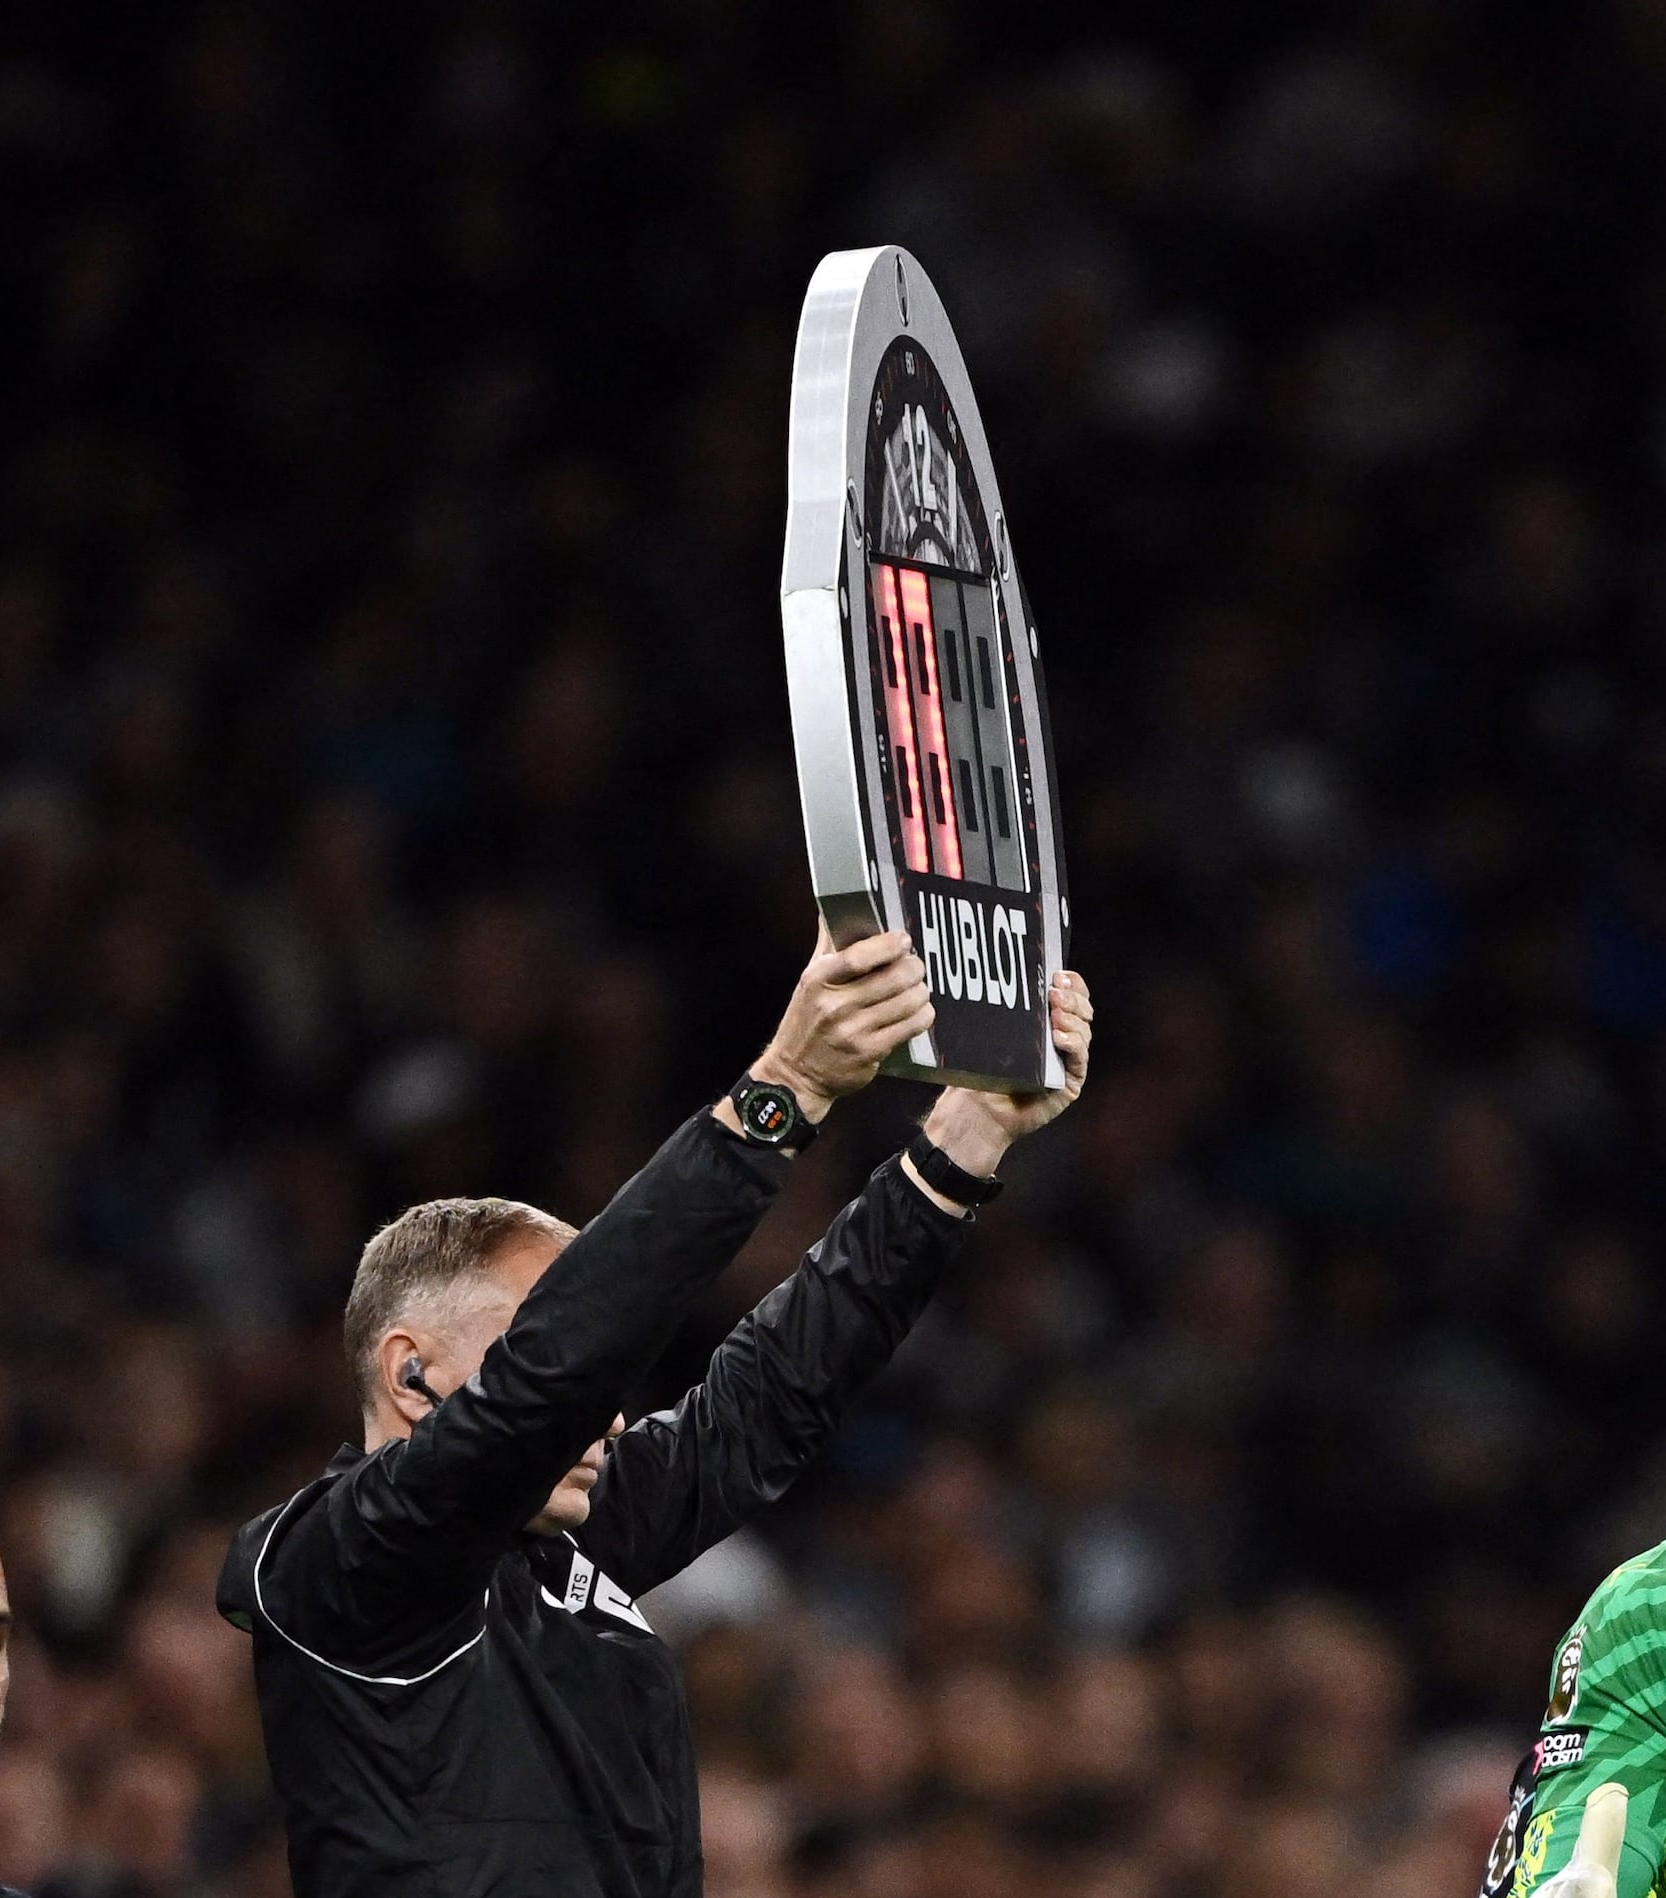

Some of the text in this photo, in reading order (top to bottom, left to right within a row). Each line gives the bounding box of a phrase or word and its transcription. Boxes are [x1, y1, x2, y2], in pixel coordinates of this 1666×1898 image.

[919, 890, 1031, 1011] HUBLOT
[570, 1573, 588, 1602] RTS
[1543, 1733, 1581, 1751] oom
